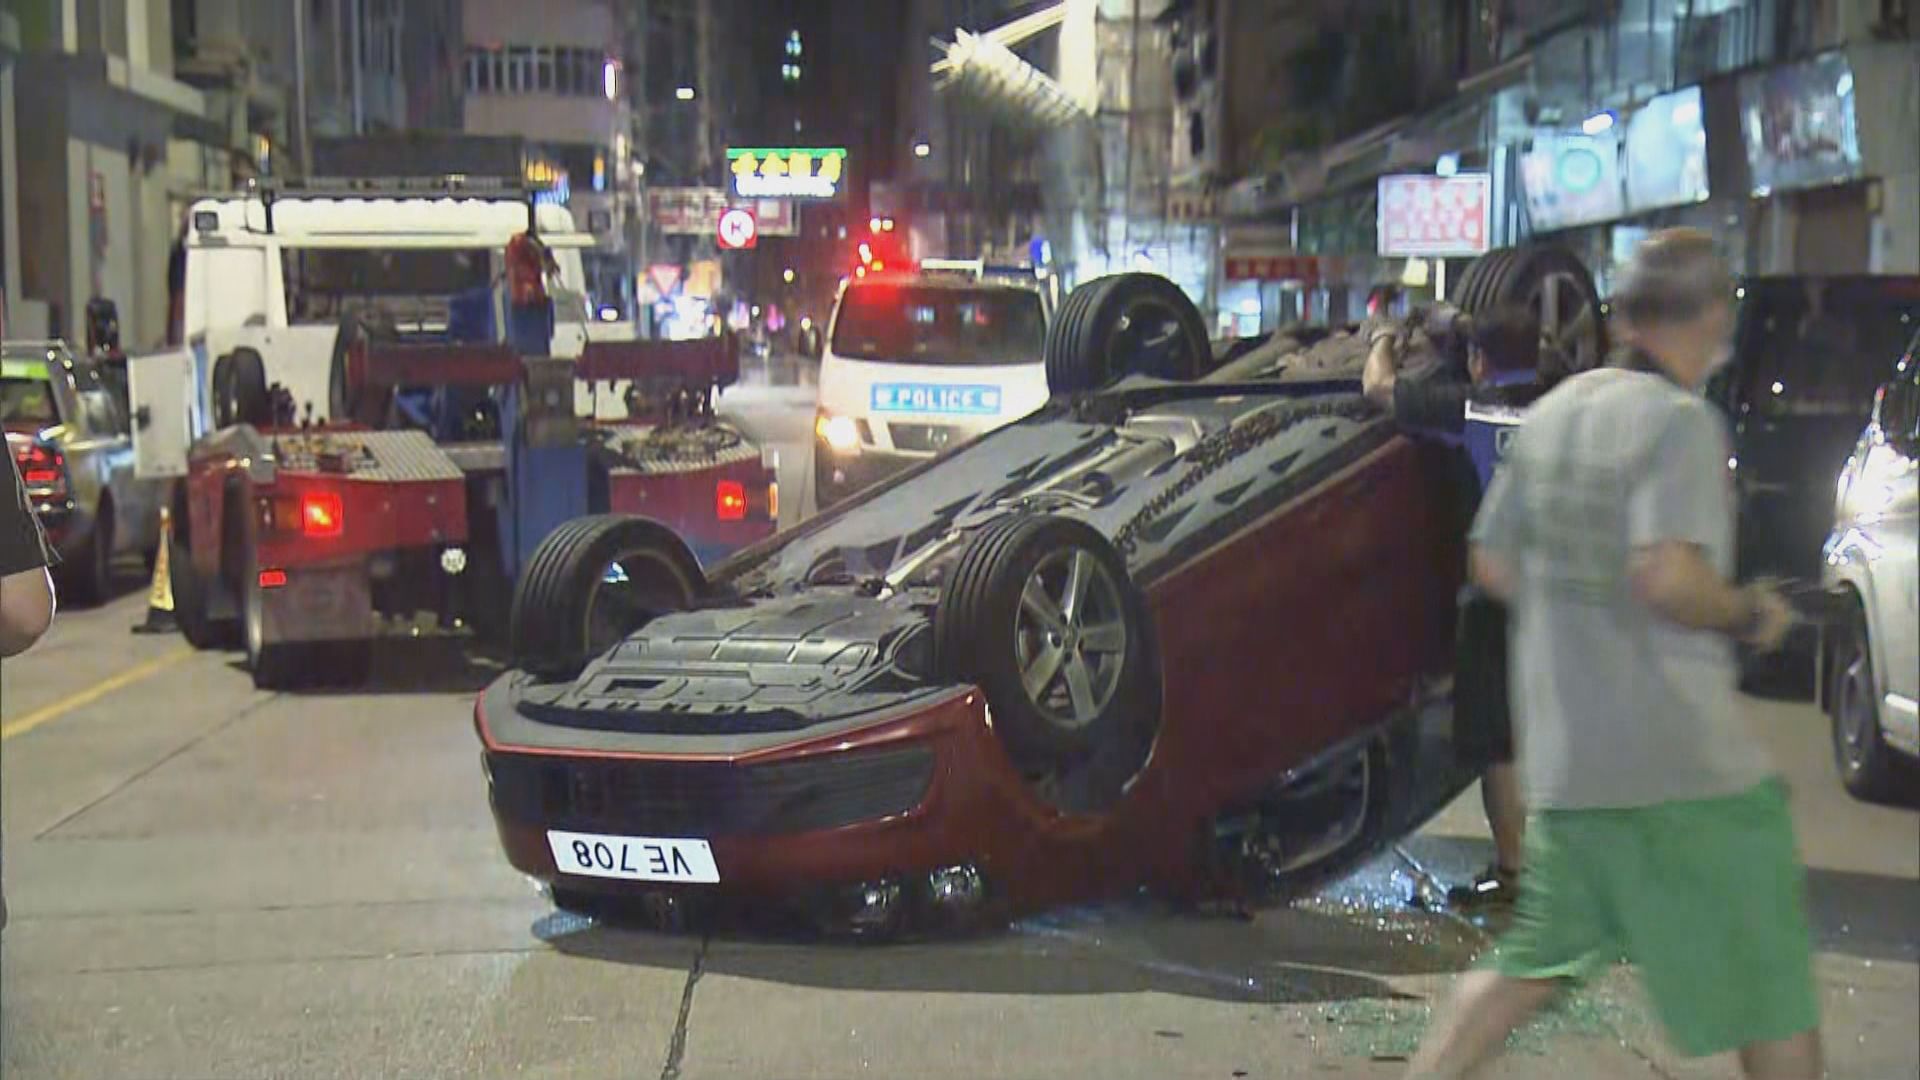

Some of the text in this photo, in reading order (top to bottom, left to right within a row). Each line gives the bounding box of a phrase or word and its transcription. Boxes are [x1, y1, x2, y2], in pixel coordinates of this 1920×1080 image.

[898, 388, 974, 407] POLICE
[572, 839, 692, 875] VE 708
